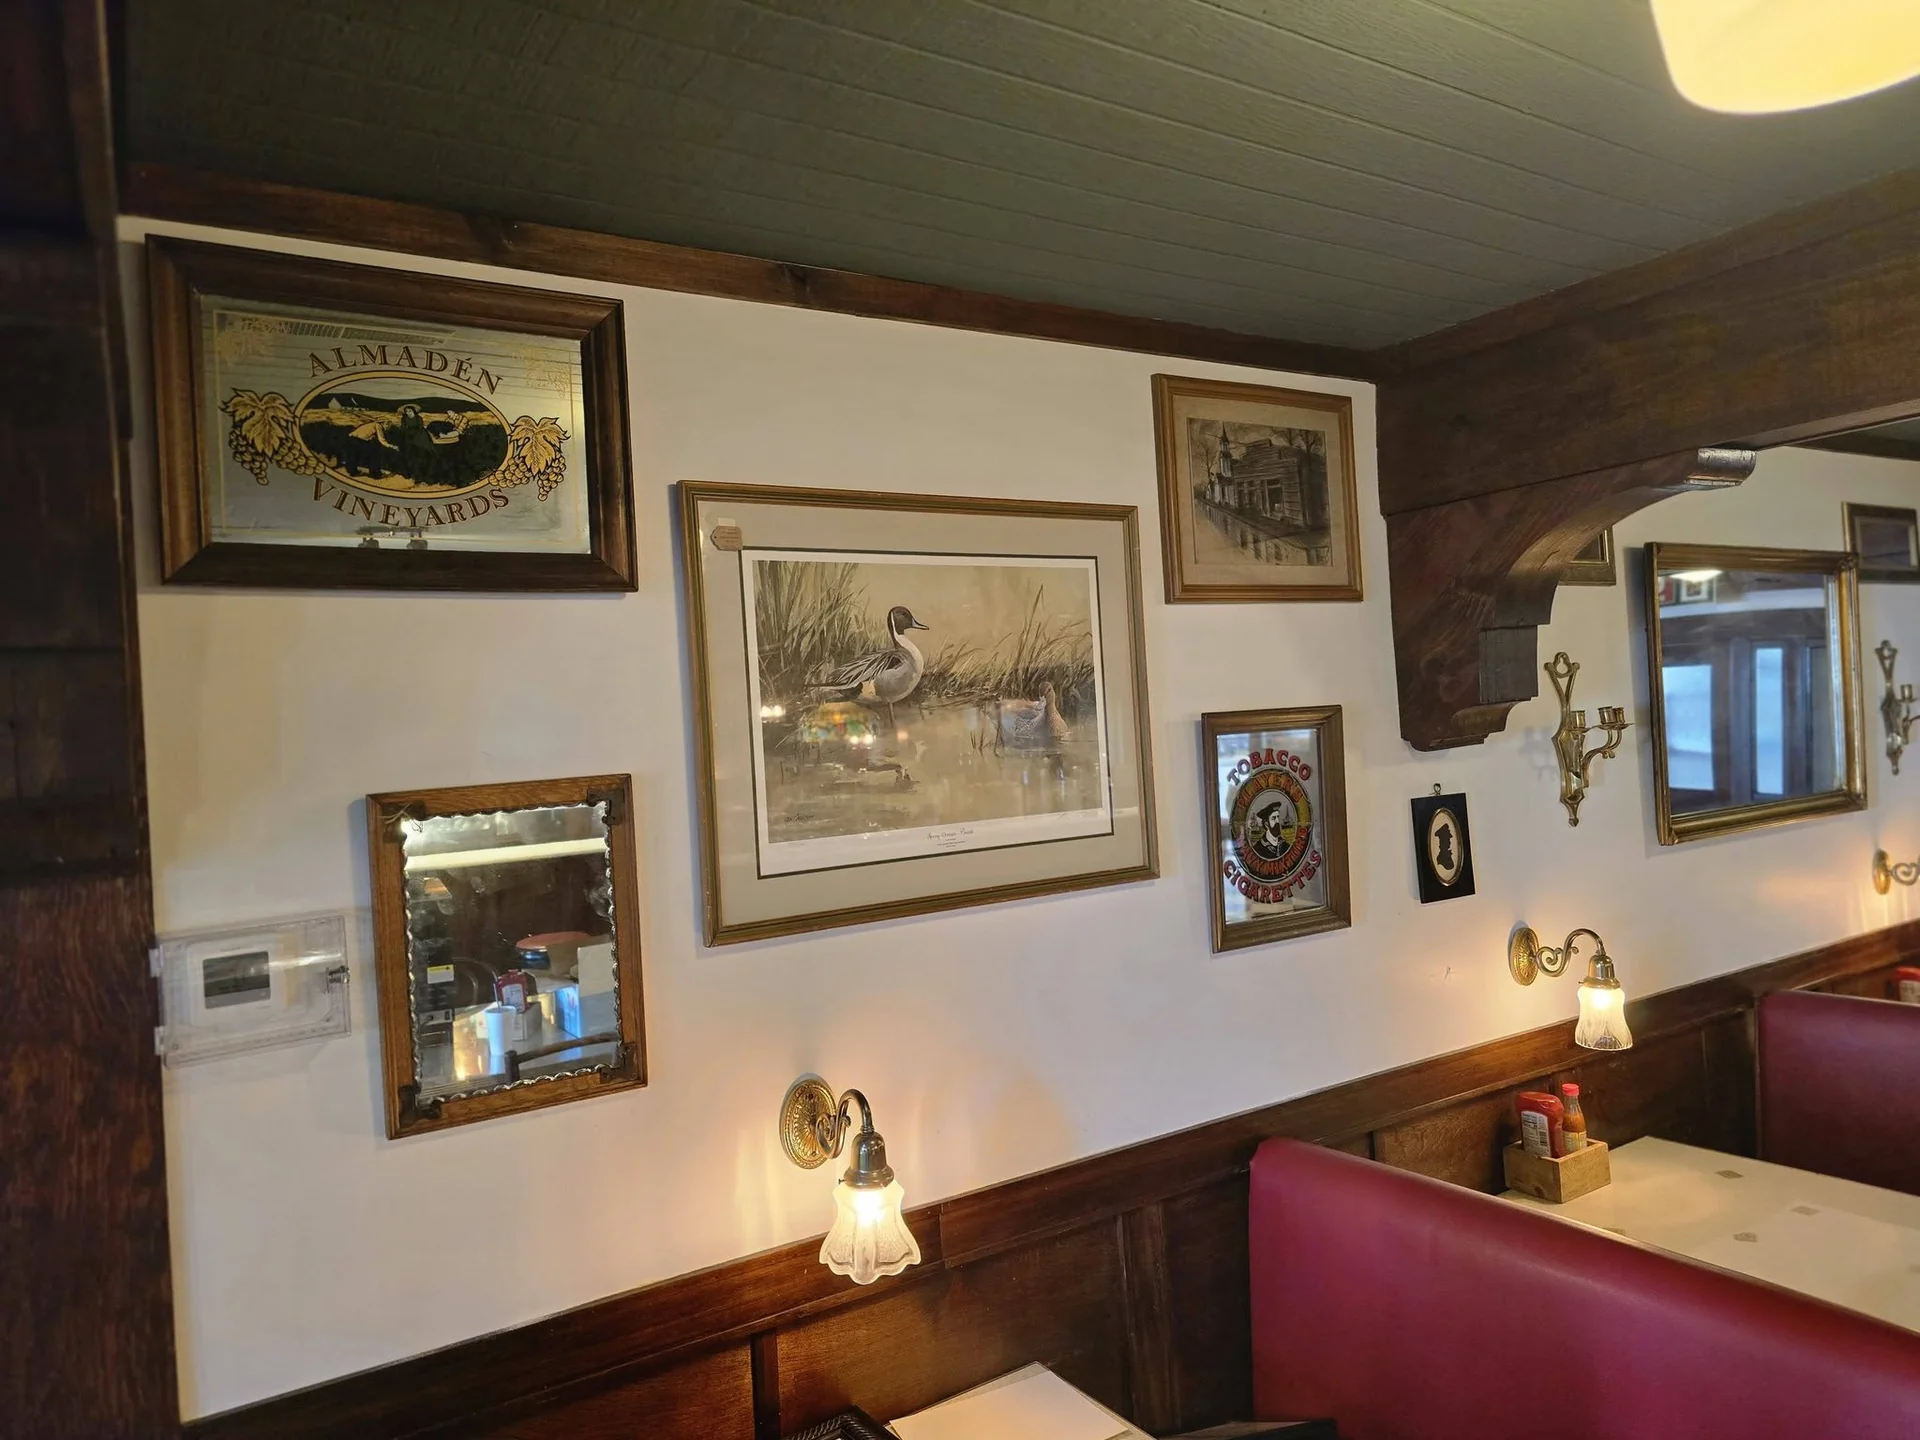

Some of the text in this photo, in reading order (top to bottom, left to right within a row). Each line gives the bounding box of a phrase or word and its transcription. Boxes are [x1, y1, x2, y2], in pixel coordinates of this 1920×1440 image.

[308, 344, 504, 395] ALMADÉN
[311, 477, 510, 528] VINEYARDS
[1227, 747, 1312, 787] TOBACCO
[1223, 849, 1322, 904] CIGARETTES
